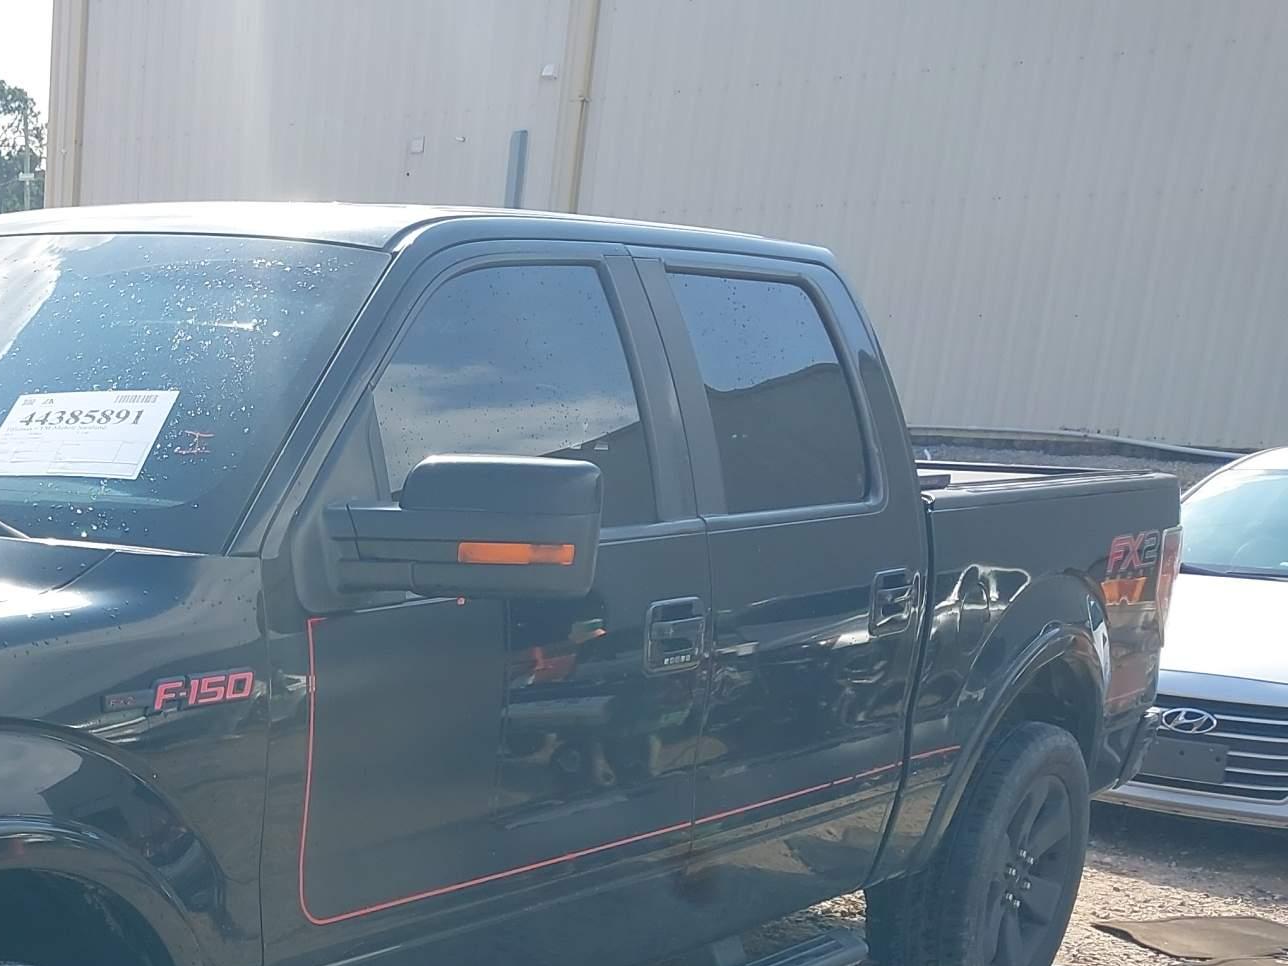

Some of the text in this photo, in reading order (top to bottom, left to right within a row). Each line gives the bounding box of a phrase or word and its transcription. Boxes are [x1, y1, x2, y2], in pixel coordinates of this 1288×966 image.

[18, 408, 145, 427] 44385891
[1106, 529, 1161, 573] FX2
[154, 671, 255, 711] F-150
